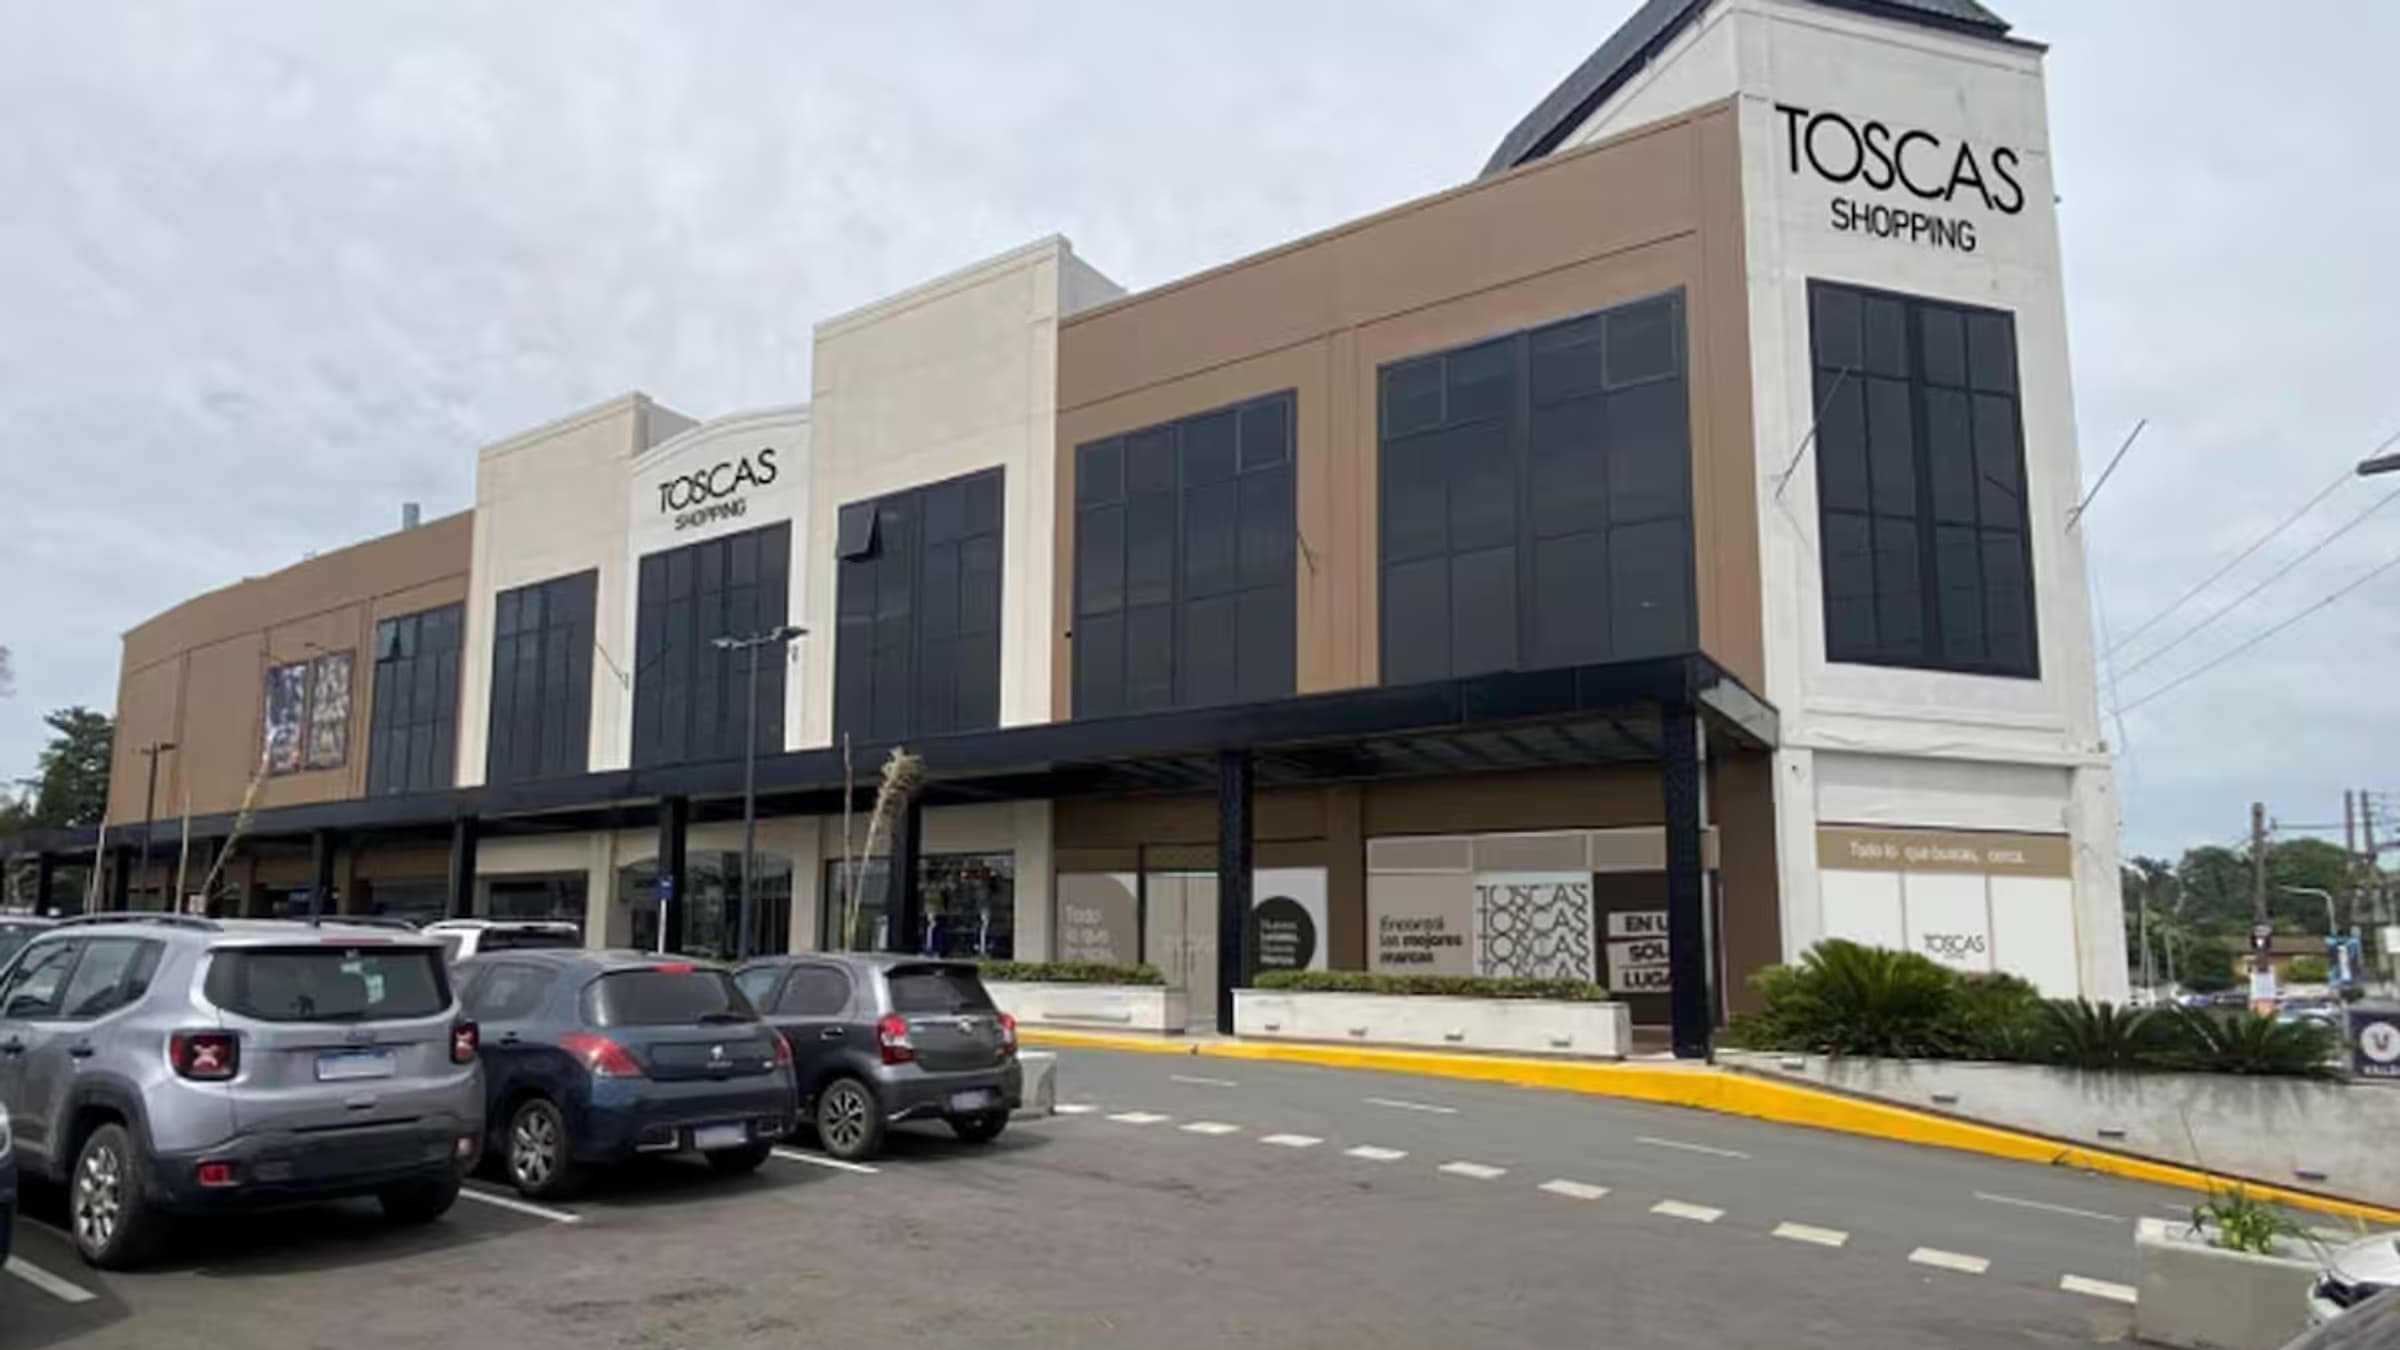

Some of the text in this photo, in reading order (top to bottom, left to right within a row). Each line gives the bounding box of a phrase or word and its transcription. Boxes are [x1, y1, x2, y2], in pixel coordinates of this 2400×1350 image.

[1774, 103, 2025, 215] TOSCAS
[1830, 198, 1977, 252] SHOPPING
[657, 447, 778, 513] TOSCAS
[674, 498, 747, 530] SHOPPING
[1850, 841, 1882, 858] Todo
[1475, 905, 1590, 934] TOSCAS
[1624, 915, 1653, 932] EN
[1403, 933, 1464, 950] mejores
[1476, 931, 1591, 960] TOSCAS
[1923, 934, 1986, 954] TOSCAS
[1379, 951, 1434, 964] marcas
